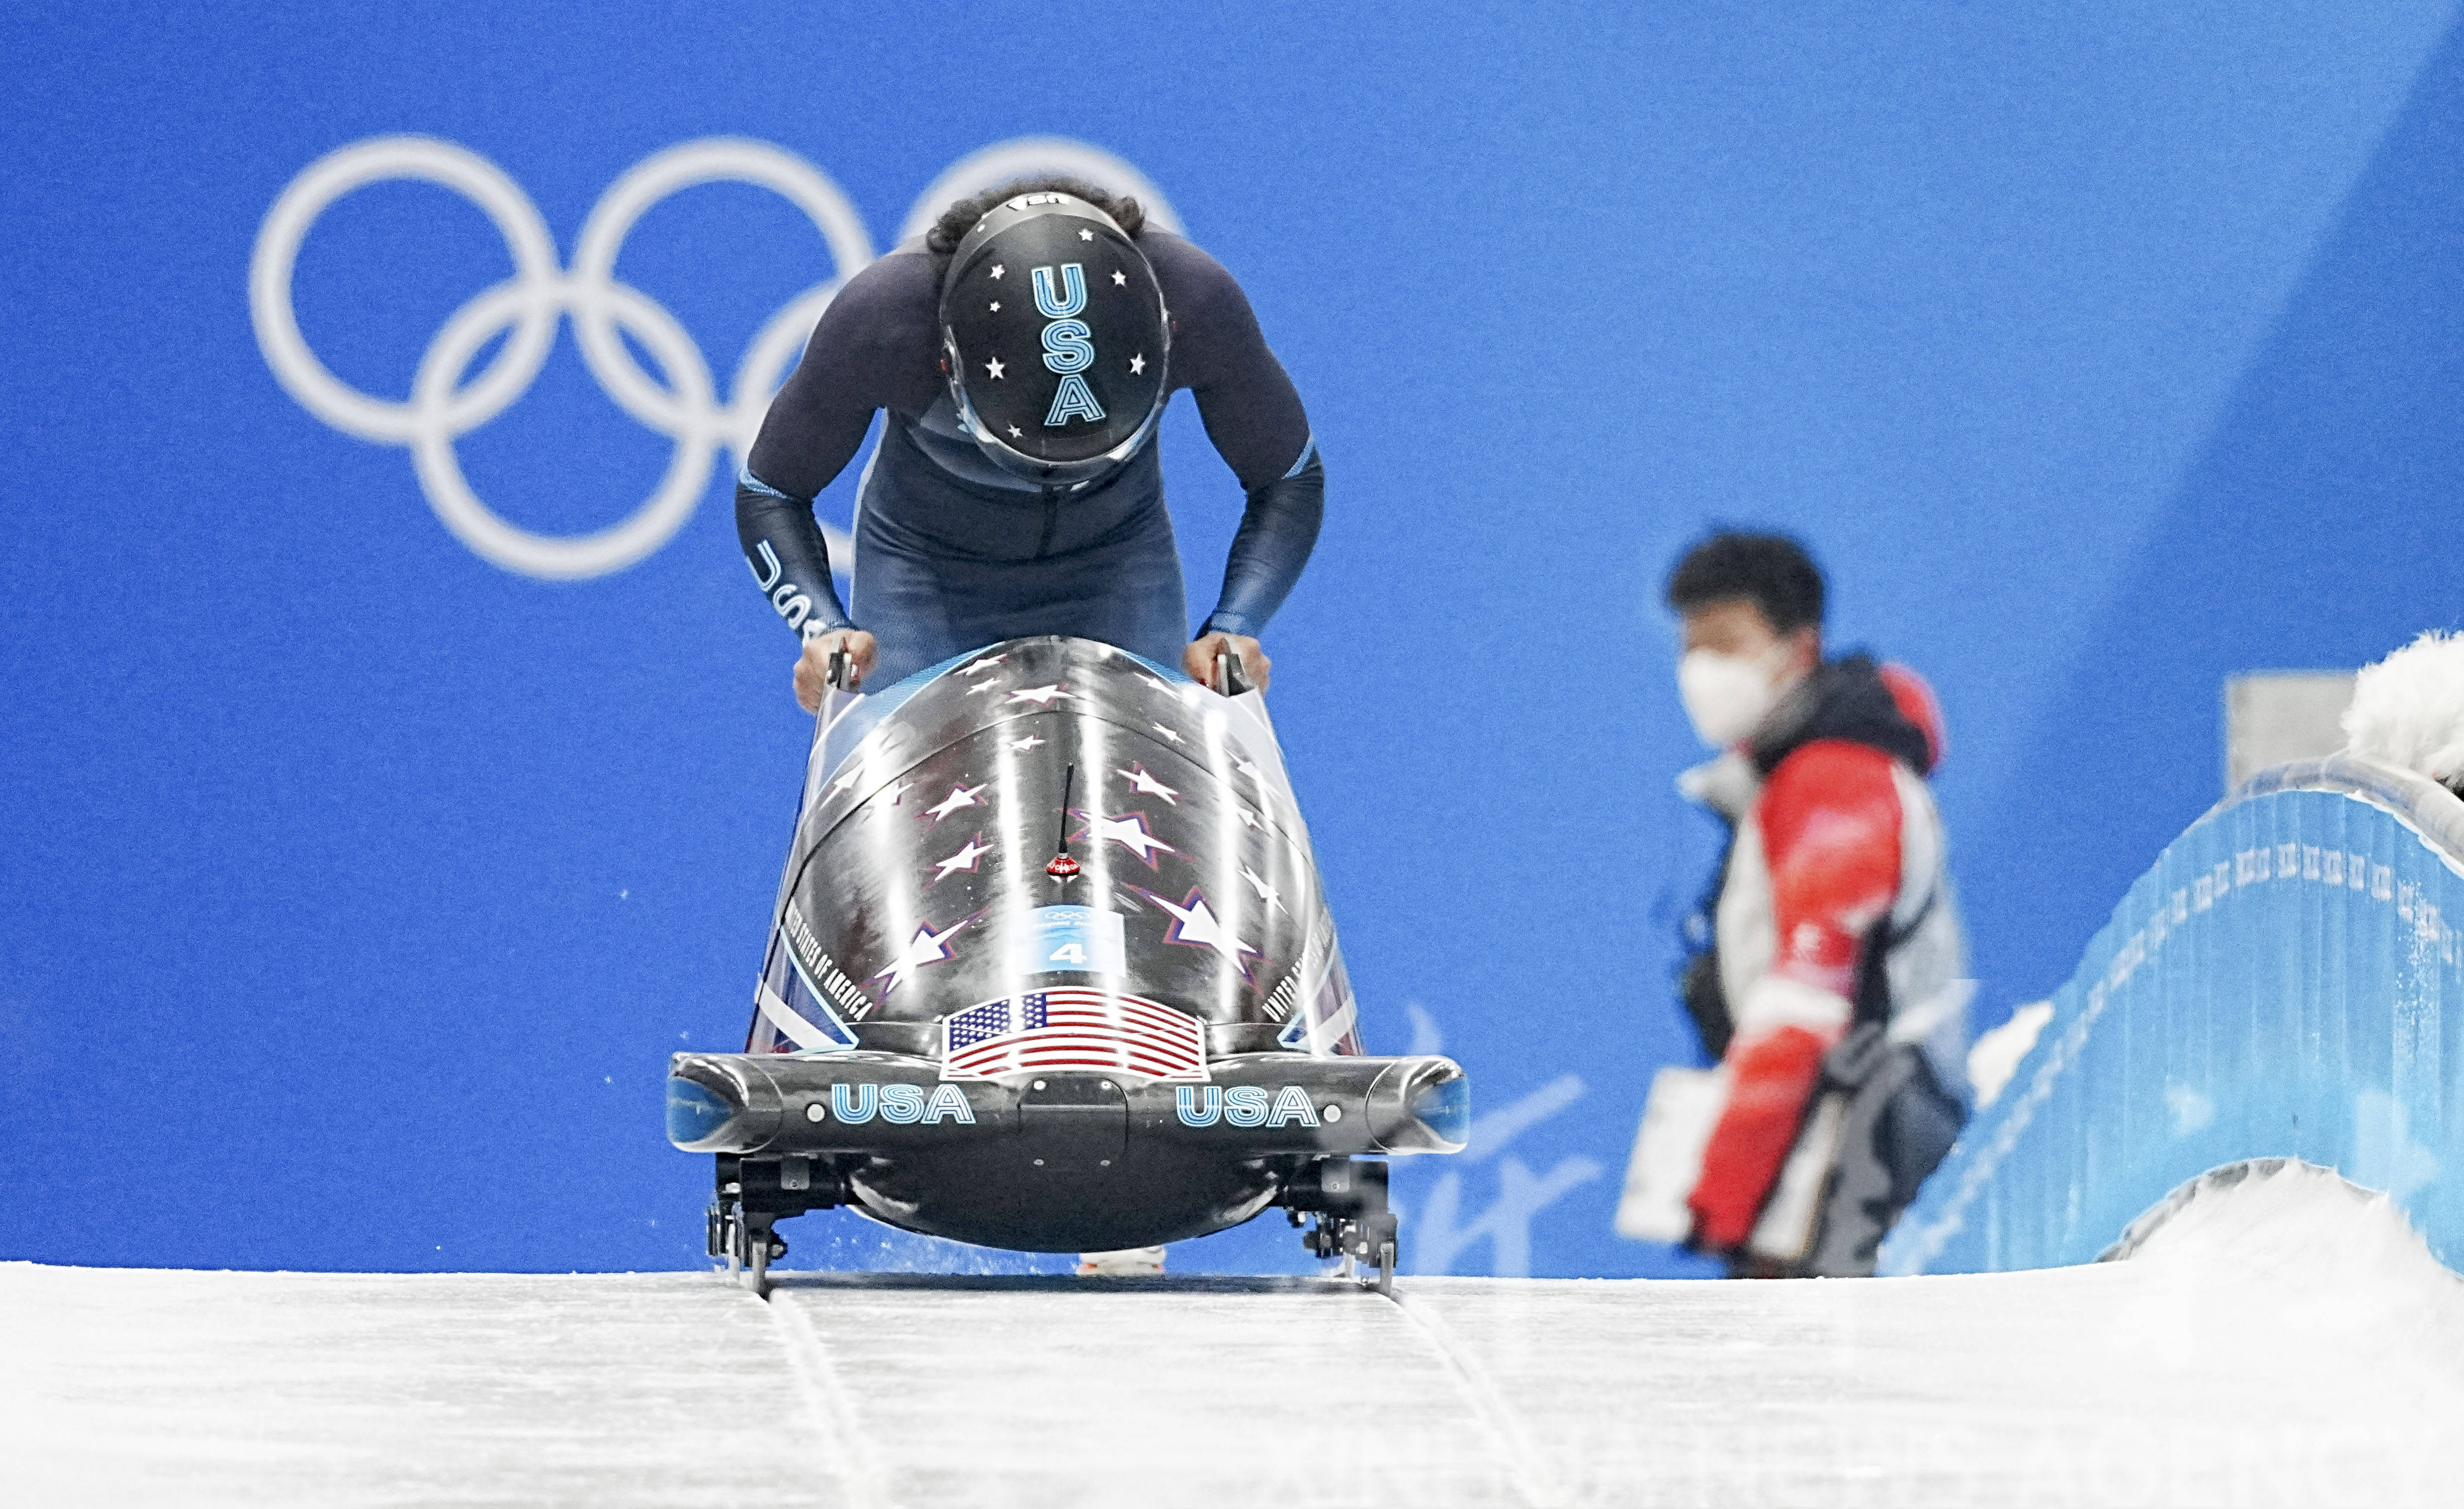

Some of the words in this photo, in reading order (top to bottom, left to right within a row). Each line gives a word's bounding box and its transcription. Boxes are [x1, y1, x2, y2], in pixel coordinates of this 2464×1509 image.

[1031, 263, 1106, 427] USA
[814, 954, 833, 980] OF
[1049, 942, 1088, 964] 4
[823, 968, 873, 1022] AMERICA
[831, 1083, 977, 1125] USA
[1175, 1085, 1321, 1128] USA
